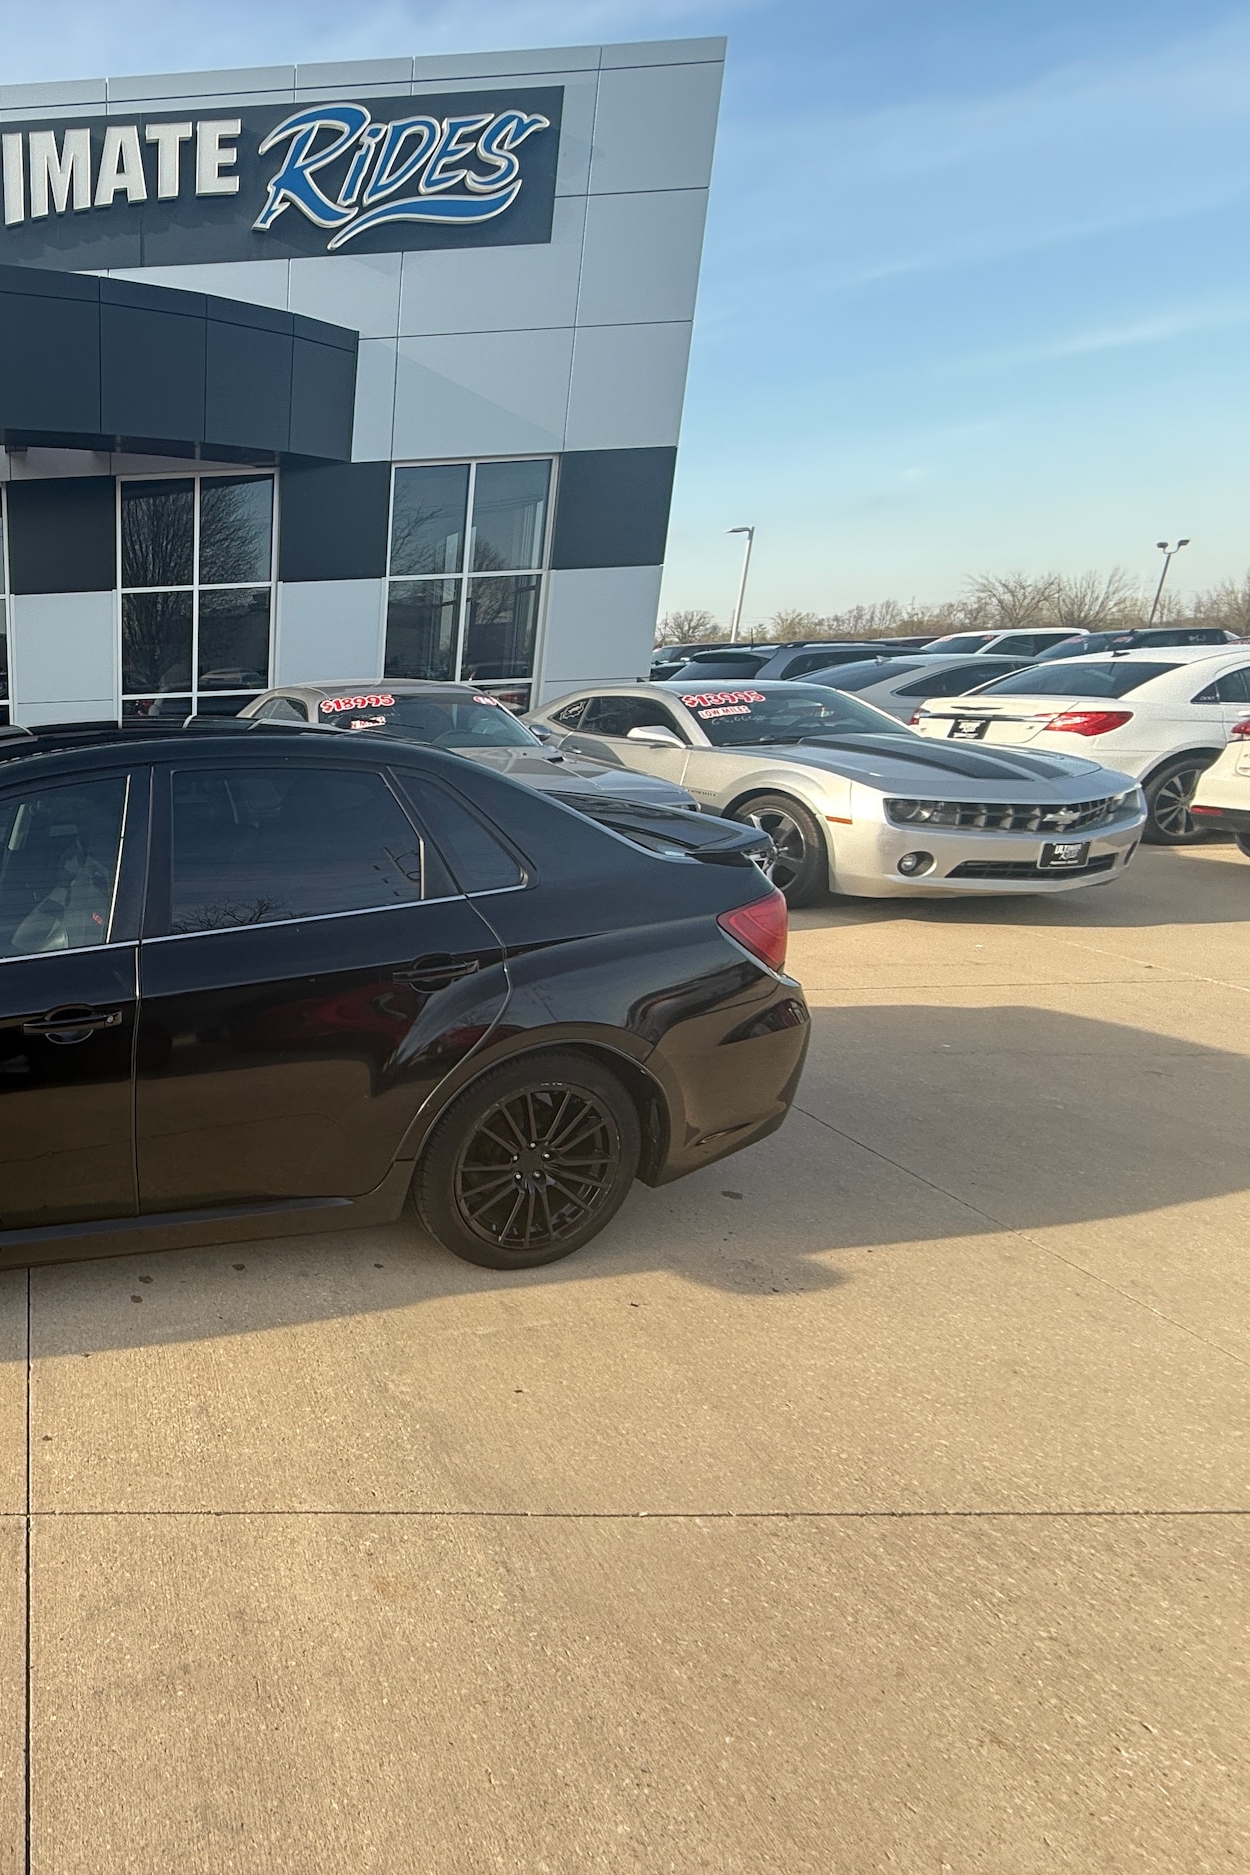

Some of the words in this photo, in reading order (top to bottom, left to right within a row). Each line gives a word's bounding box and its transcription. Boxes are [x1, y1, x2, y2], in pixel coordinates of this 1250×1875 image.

[320, 694, 395, 713] $18995
[682, 690, 766, 708] $13995
[699, 709, 720, 718] LOW
